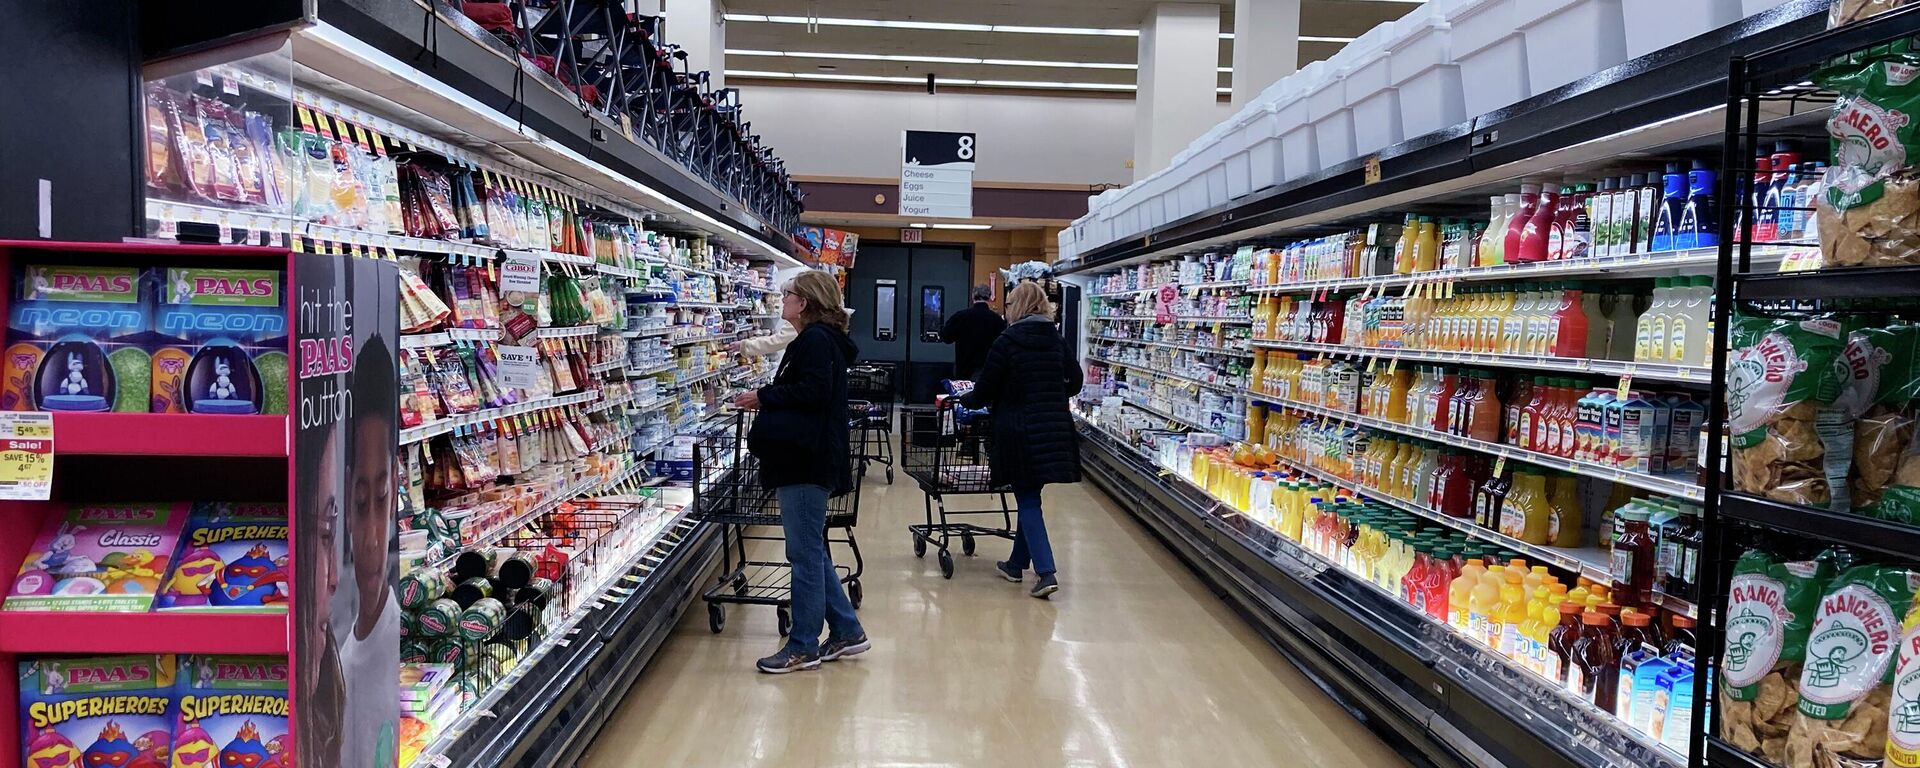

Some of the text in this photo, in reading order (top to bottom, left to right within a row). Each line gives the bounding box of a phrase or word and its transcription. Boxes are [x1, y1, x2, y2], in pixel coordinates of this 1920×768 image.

[957, 135, 974, 160] 8
[903, 170, 935, 179] Cheese
[903, 182, 924, 192] Eggs
[903, 194, 925, 202] Juice
[903, 206, 930, 215] Yogurt
[904, 230, 920, 242] EXIT
[52, 273, 132, 293] PAAS
[194, 277, 273, 296] PAAS
[19, 307, 142, 328] neon
[300, 285, 353, 335] hit the
[164, 310, 284, 332] neon
[300, 334, 353, 379] PAAS
[501, 353, 524, 361] SAVE
[300, 381, 353, 430] button
[9, 440, 42, 450] Sale!
[4, 453, 23, 461] SAVE
[79, 505, 156, 521] PAAS
[236, 505, 289, 517] PAA
[97, 529, 162, 547] Classic
[192, 525, 289, 547] SUPERHER
[1825, 594, 1889, 655] RANCHERO
[67, 664, 150, 684] PAAS
[29, 697, 170, 728] SUPERHEROES
[180, 695, 289, 723] SUPERHEROE
[1799, 699, 1827, 717] SALTED
